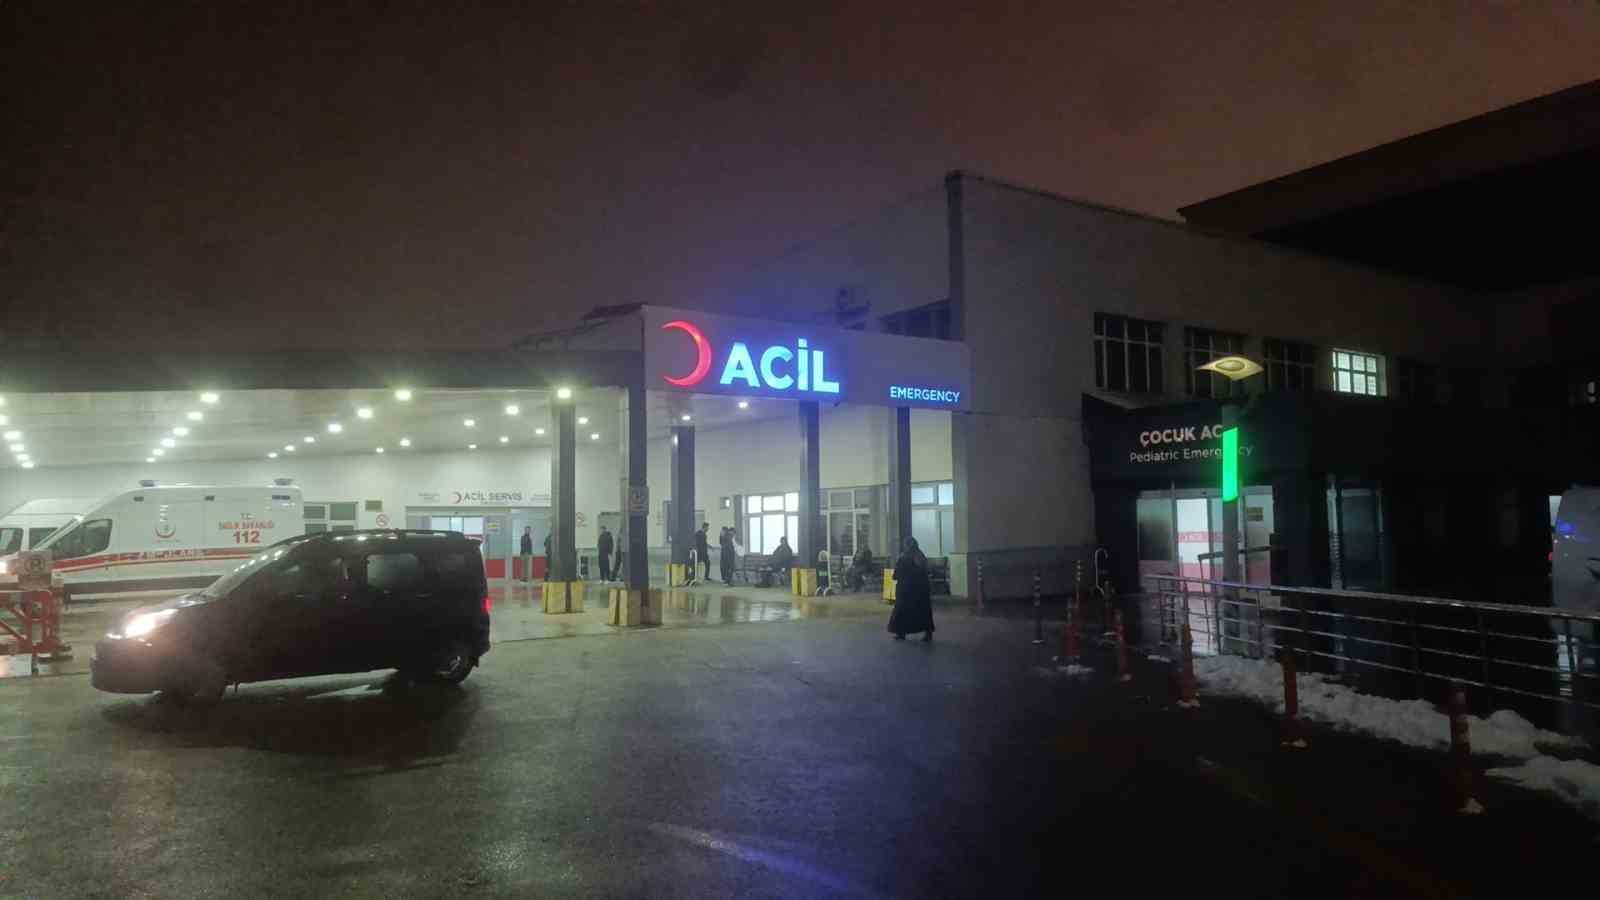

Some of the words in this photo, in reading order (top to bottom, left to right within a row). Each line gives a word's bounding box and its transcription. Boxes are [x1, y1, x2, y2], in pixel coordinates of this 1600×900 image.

[720, 338, 840, 393] ACİL
[889, 386, 960, 402] EMERGENCY
[1139, 427, 1196, 447] ÇOCUK
[1129, 450, 1179, 462] Pediatric
[1183, 446, 1253, 460] Emergcy
[233, 531, 261, 544] 112
